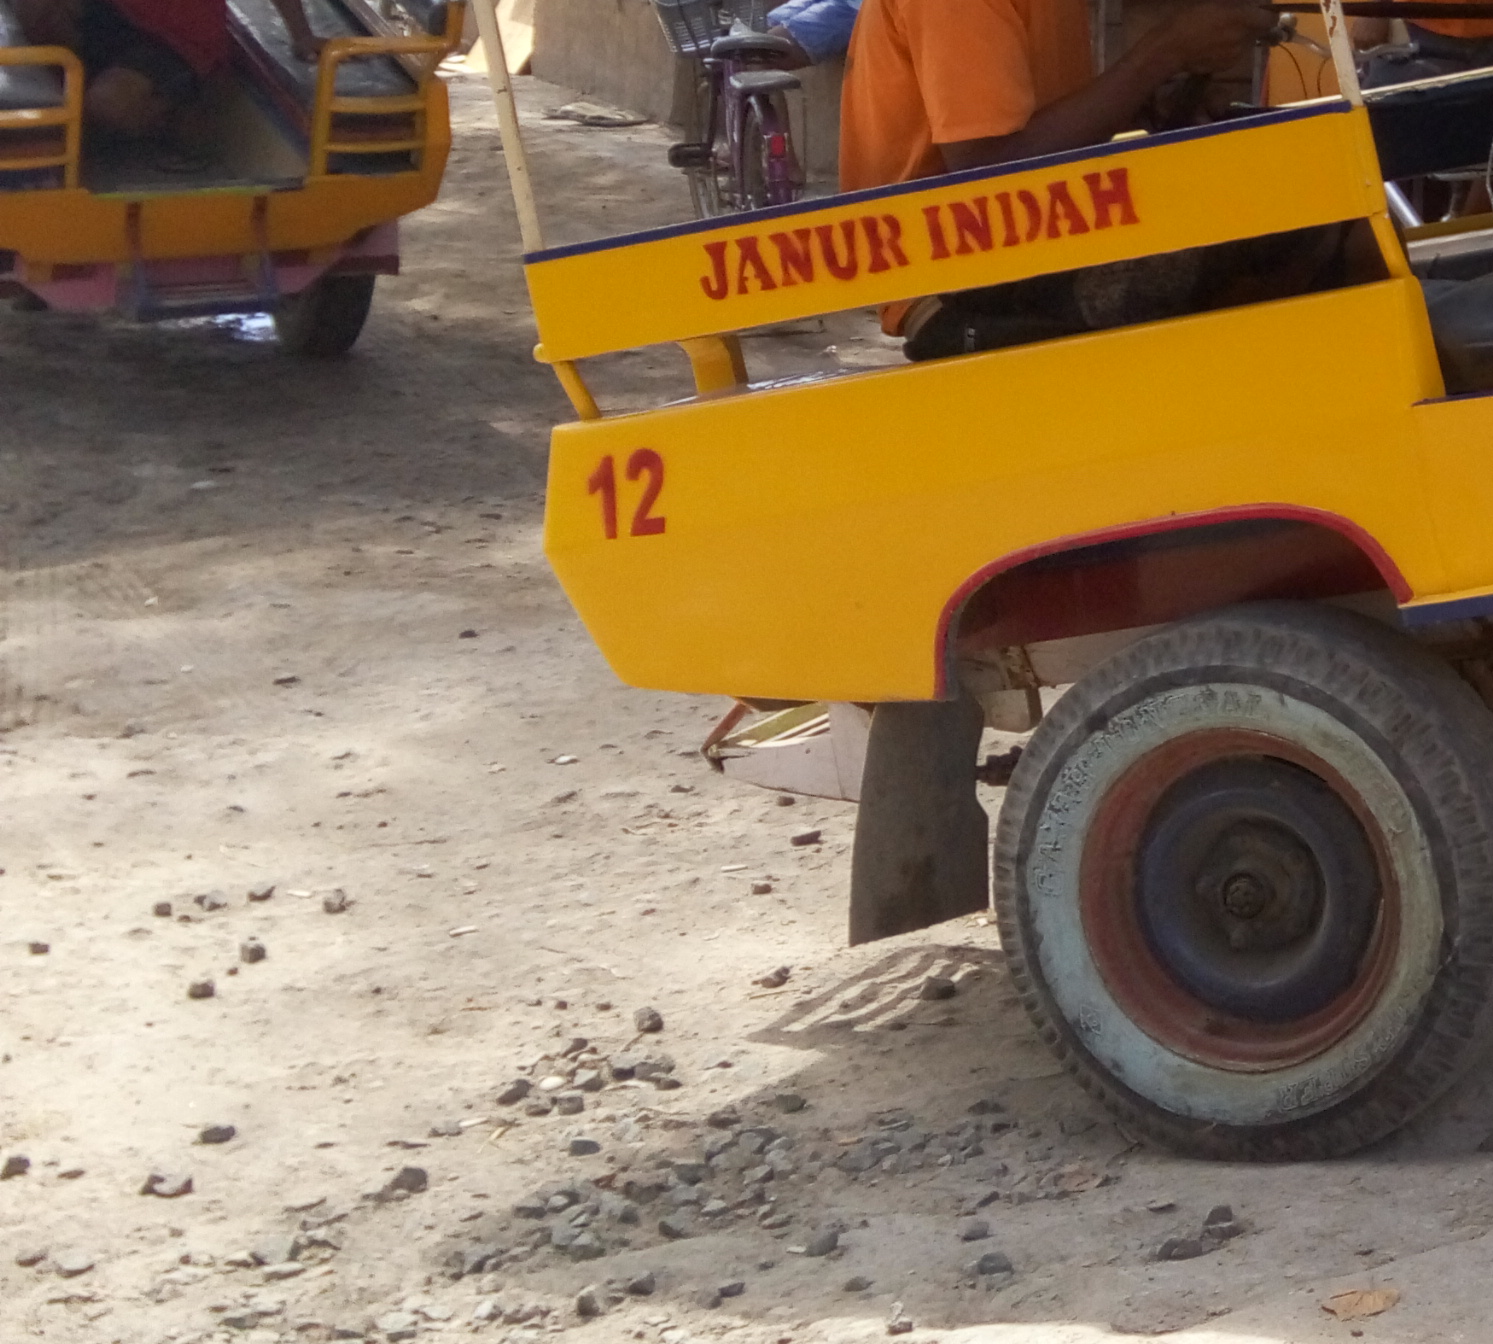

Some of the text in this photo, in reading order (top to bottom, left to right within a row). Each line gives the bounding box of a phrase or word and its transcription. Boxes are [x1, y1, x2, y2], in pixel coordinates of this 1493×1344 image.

[700, 167, 1140, 301] JANUR INDAH
[587, 447, 666, 540] 12
